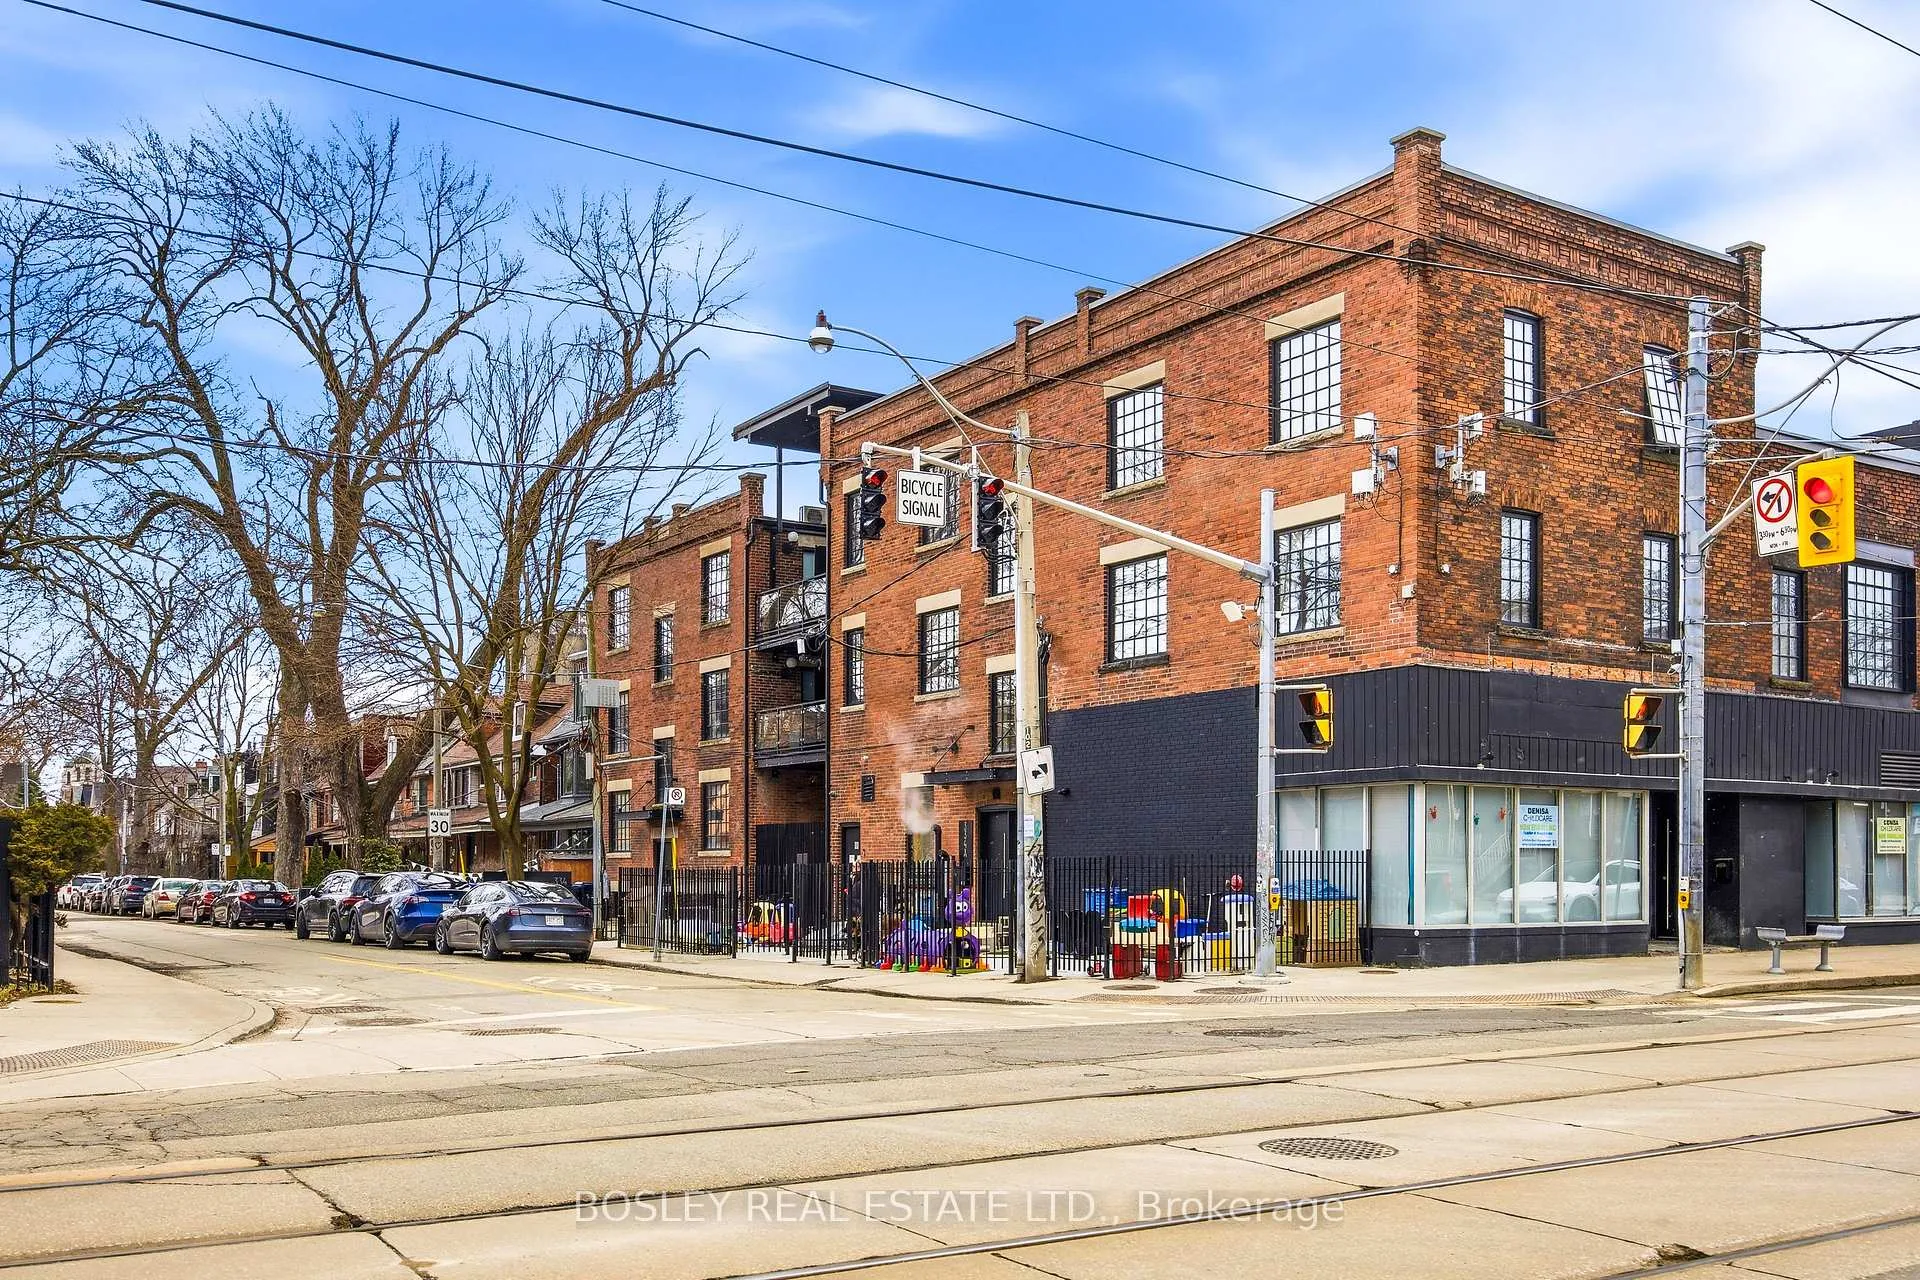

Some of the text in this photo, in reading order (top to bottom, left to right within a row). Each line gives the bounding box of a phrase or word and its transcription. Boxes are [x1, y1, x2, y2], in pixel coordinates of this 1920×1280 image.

[901, 478, 944, 498] BICYCLE
[902, 499, 942, 518] SIGNAL
[1523, 814, 1553, 822] CHILDCARE
[1527, 807, 1549, 815] DENISA
[431, 820, 449, 834] 30
